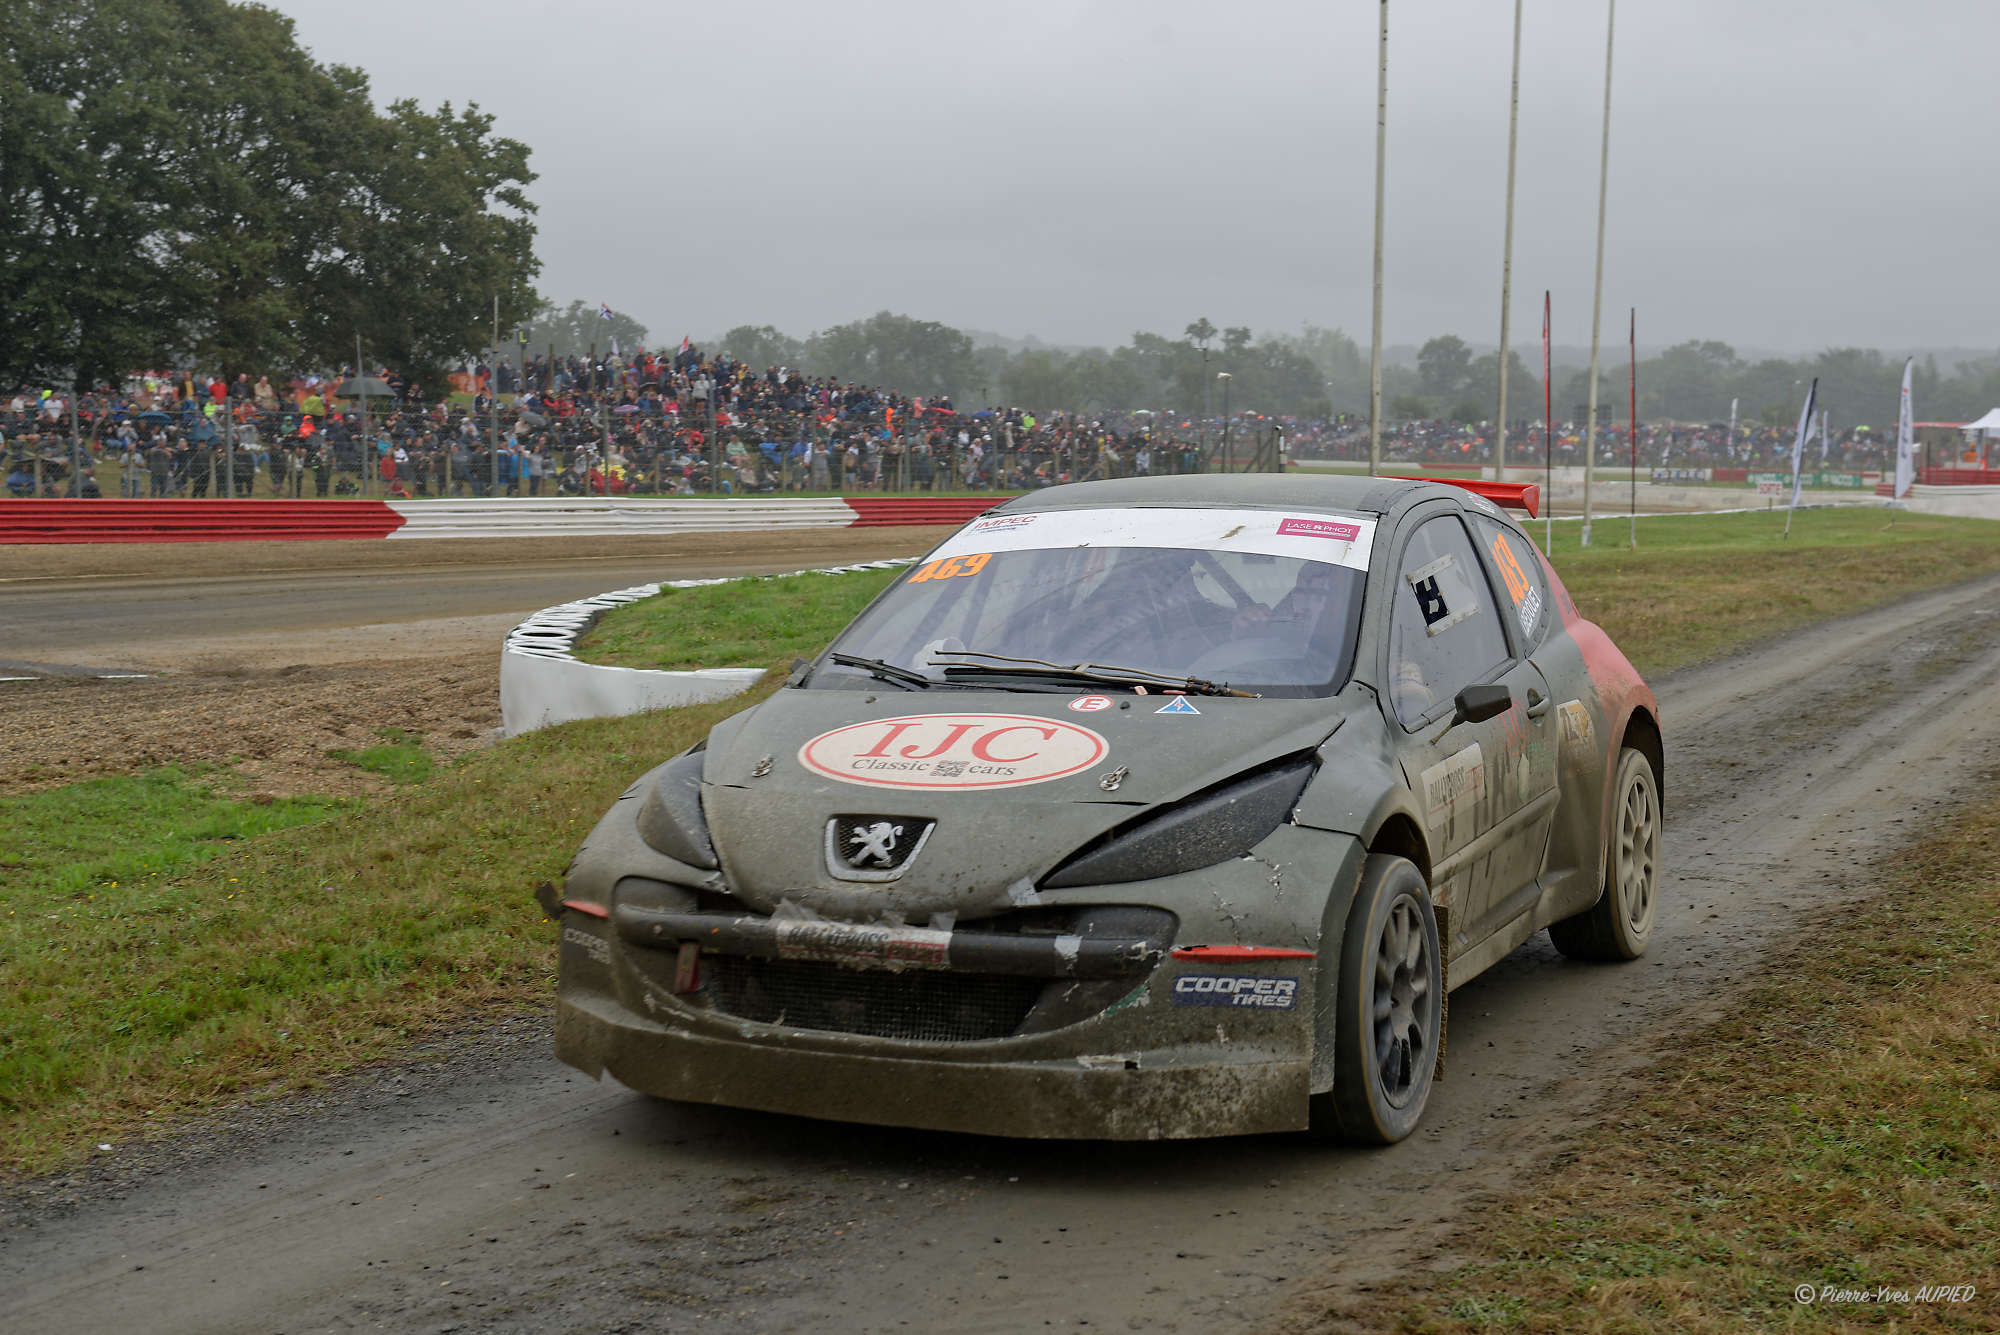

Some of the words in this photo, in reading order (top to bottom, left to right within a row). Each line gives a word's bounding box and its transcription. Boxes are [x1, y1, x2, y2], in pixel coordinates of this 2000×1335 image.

[974, 515, 1038, 529] IMPEC
[907, 552, 993, 584] 469
[1079, 698, 1105, 710] E
[853, 722, 1059, 763] IJC
[851, 758, 930, 771] Classic
[968, 763, 1017, 776] cars
[1175, 976, 1297, 996] COOPER
[1231, 993, 1292, 1007] TIRES
